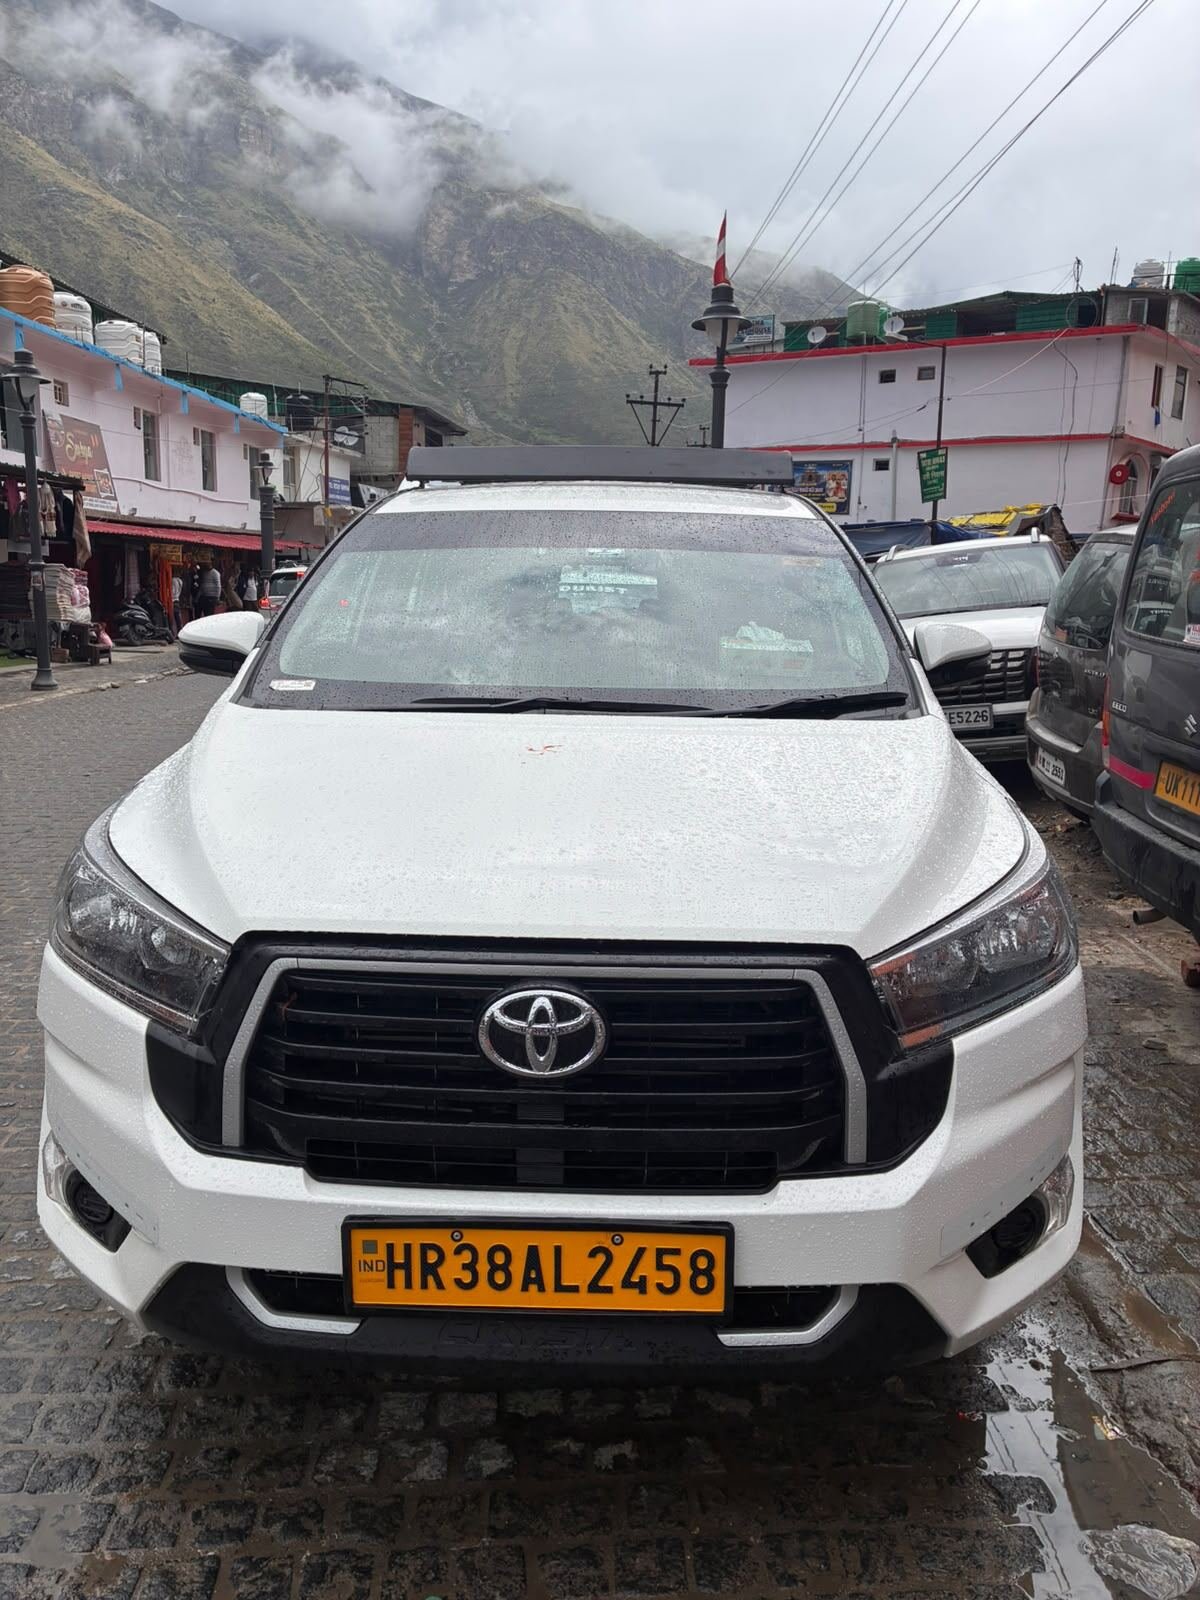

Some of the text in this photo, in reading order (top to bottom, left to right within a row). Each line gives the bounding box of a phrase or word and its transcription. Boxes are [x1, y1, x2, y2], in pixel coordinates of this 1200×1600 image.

[944, 709, 989, 724] E5226
[358, 1259, 386, 1272] IND
[386, 1242, 716, 1295] HR38AL2458
